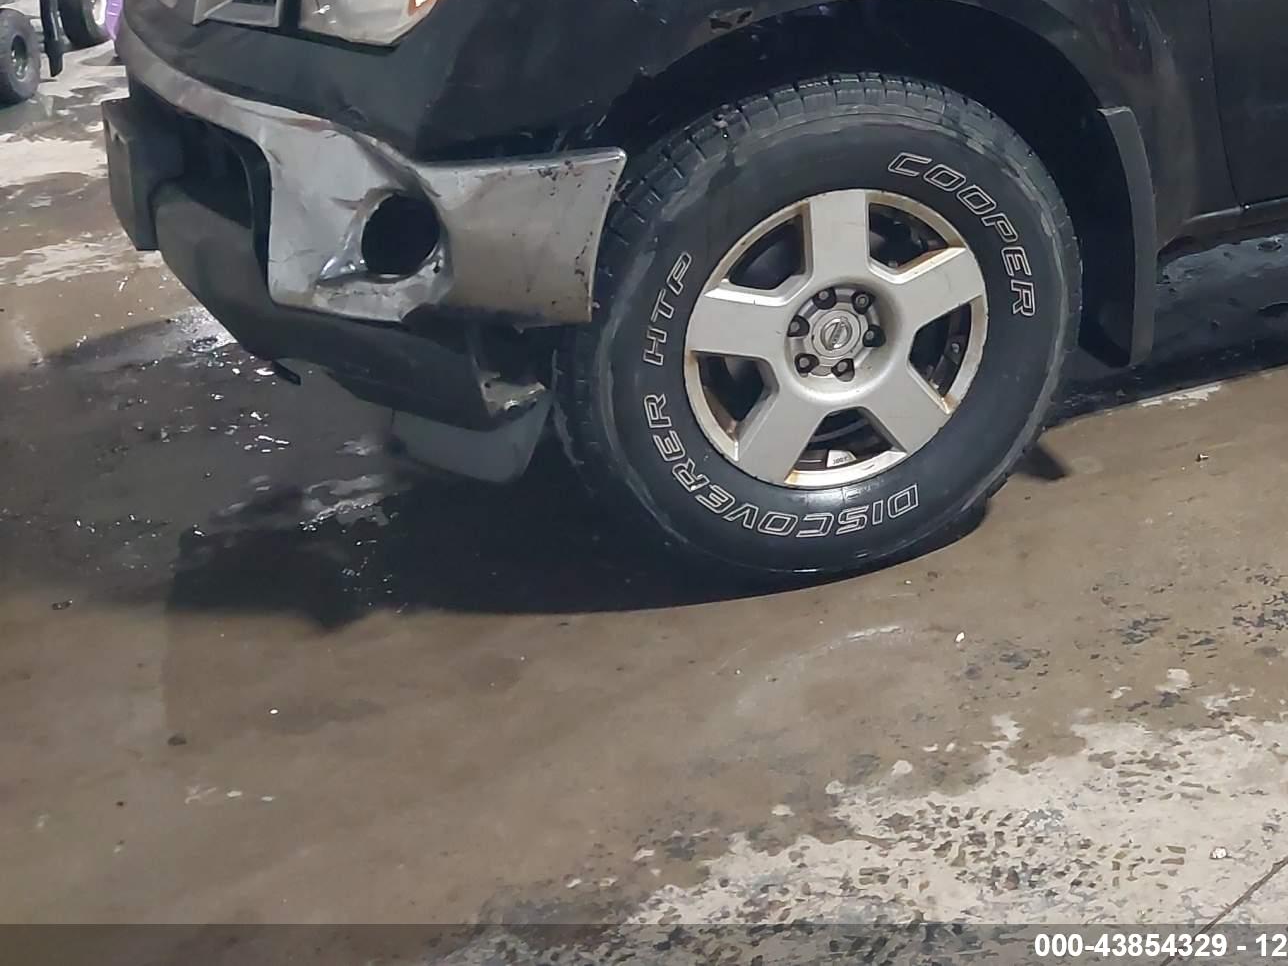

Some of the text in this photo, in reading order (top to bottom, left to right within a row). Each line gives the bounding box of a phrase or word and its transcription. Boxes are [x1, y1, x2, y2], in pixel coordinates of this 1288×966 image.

[887, 151, 1036, 318] COOPER
[642, 251, 919, 538] DISCOVERER HTP
